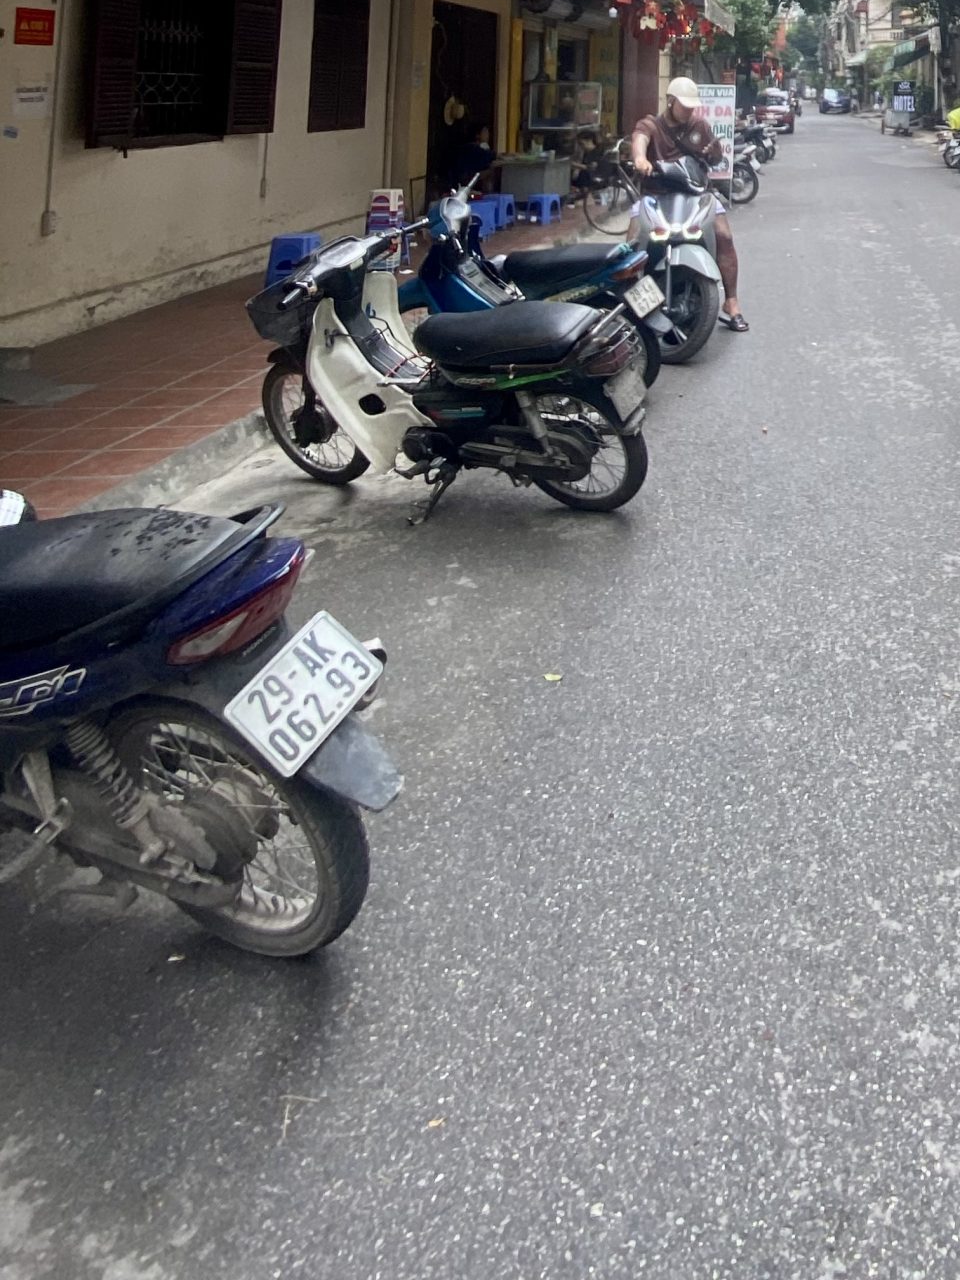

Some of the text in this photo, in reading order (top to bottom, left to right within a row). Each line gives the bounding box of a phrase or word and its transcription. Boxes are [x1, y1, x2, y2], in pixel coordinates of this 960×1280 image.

[893, 95, 915, 111] HOTEL
[247, 630, 337, 724] 29-AK
[268, 651, 371, 761] 062.93
